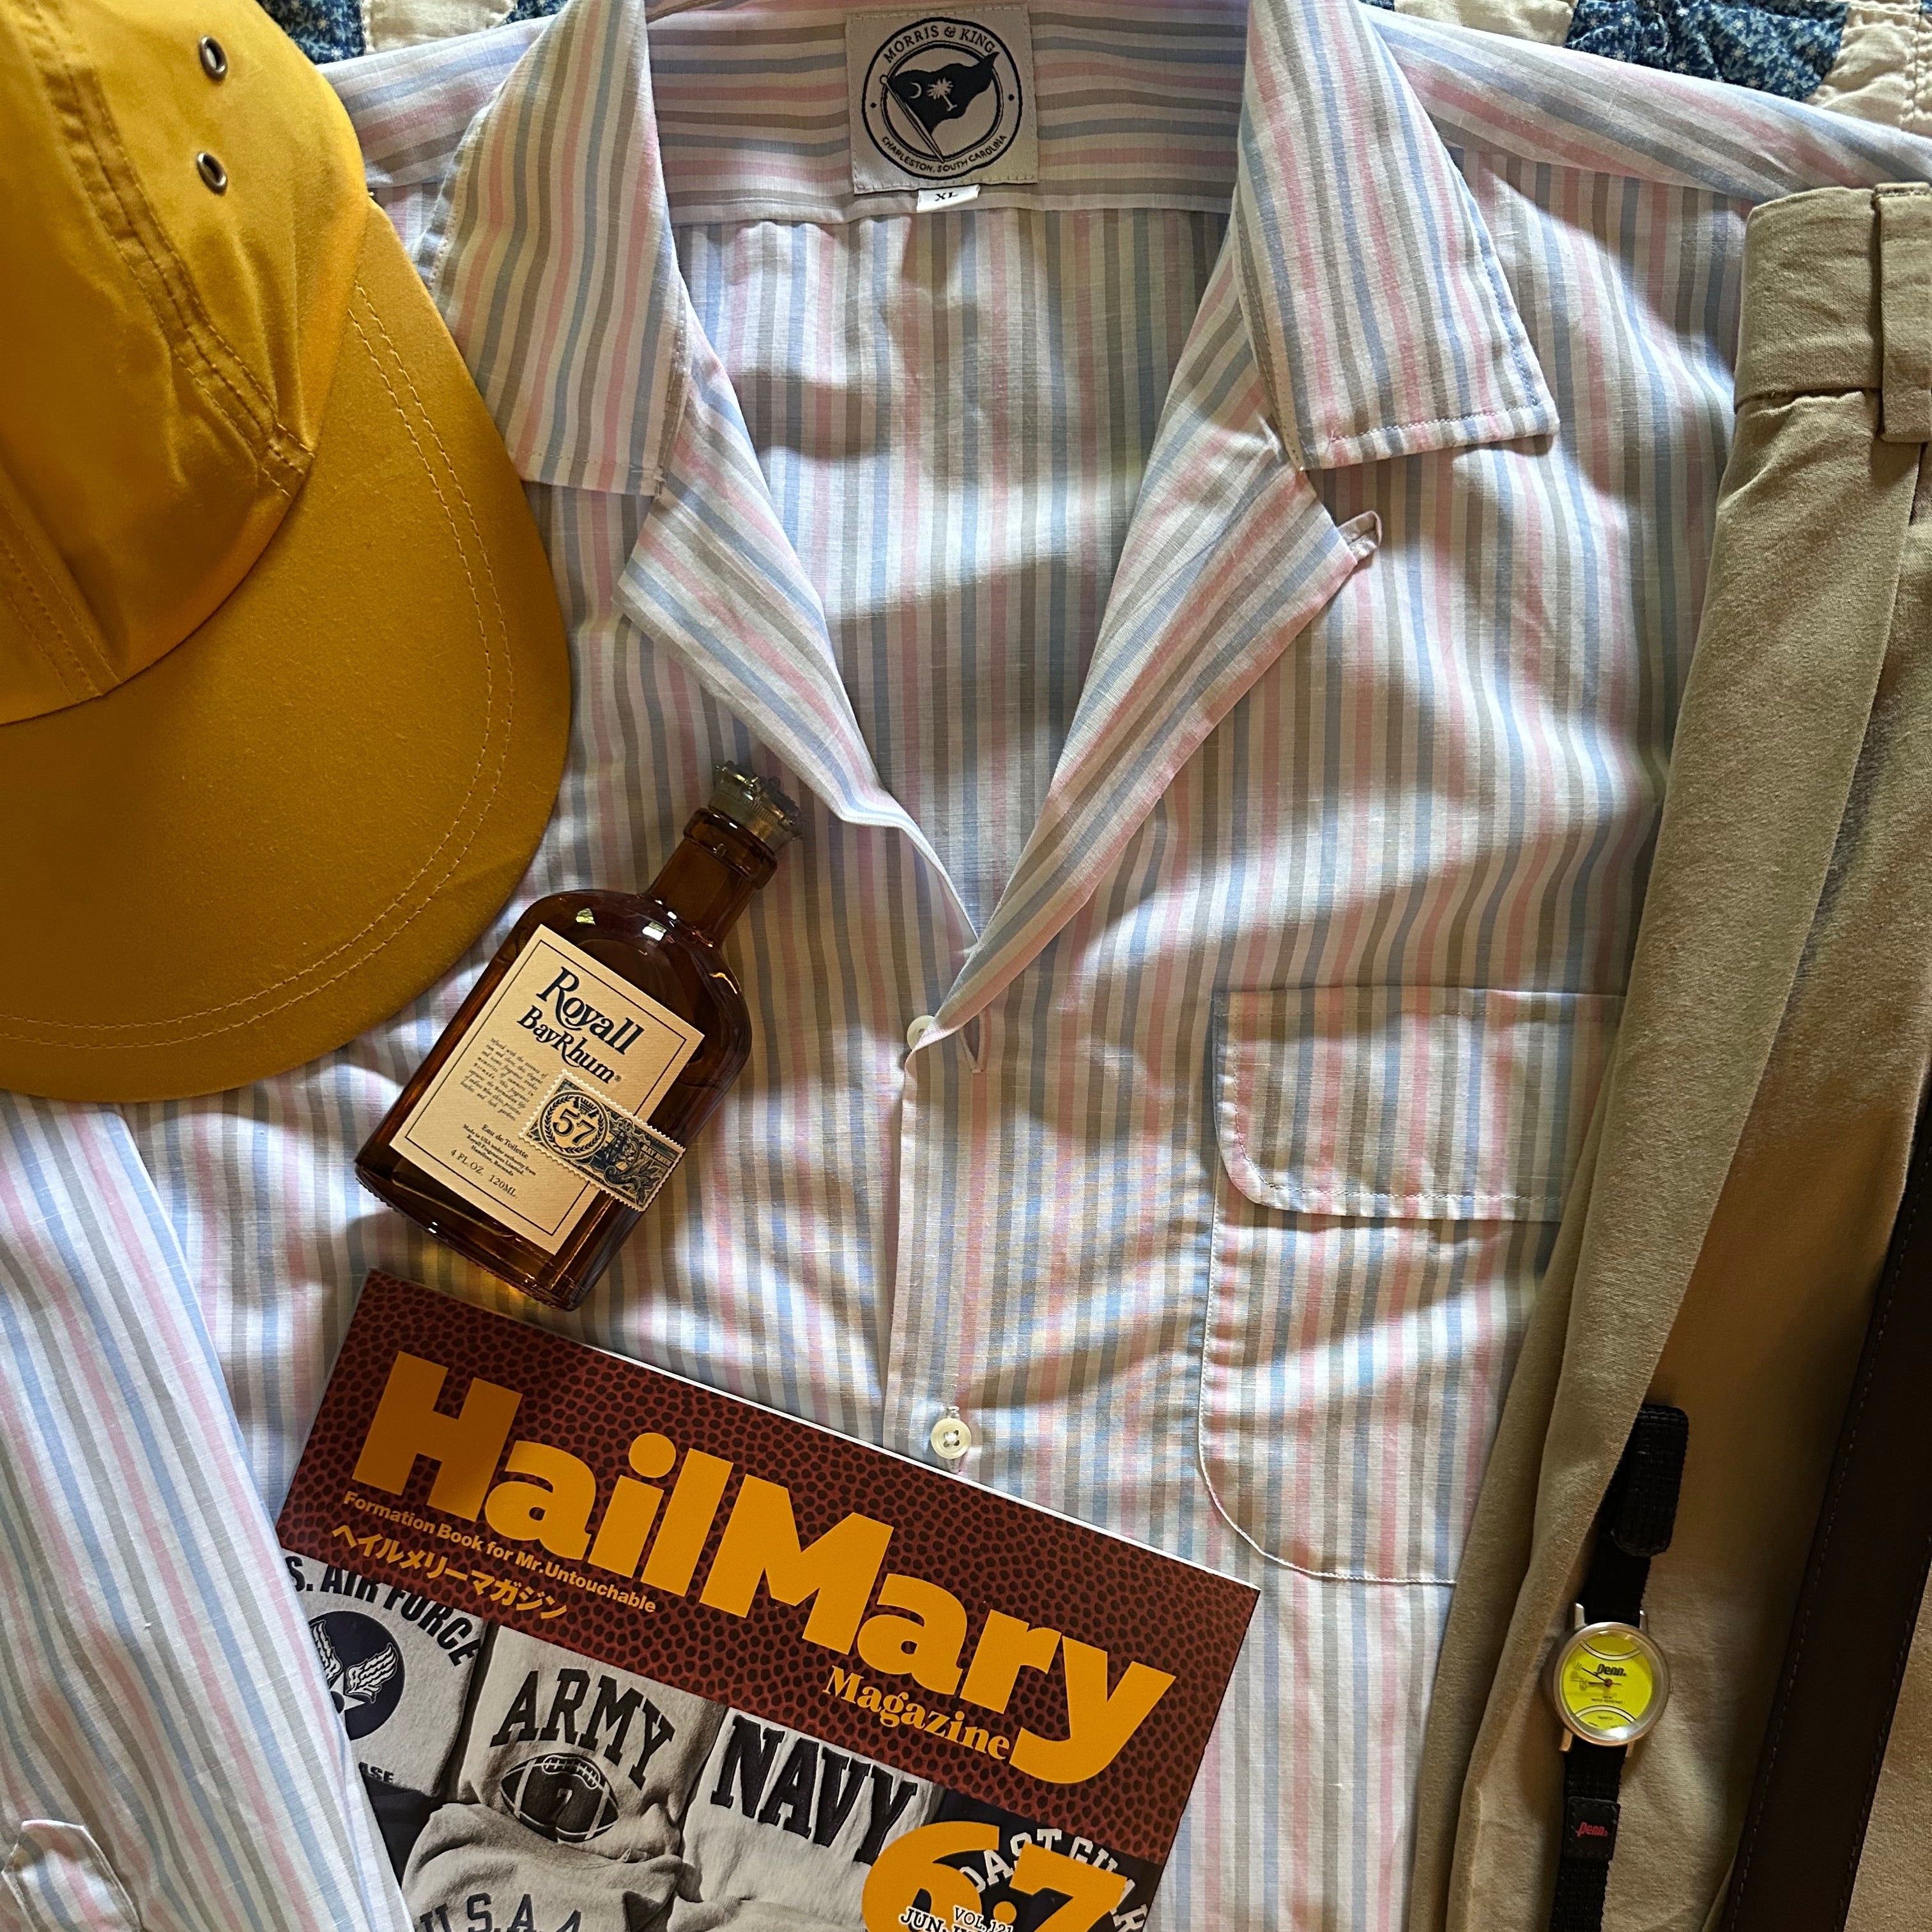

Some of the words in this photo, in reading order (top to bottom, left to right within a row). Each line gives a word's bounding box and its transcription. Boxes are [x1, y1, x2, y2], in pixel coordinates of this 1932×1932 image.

[884, 26, 939, 63] MORRIS
[944, 27, 956, 38] &
[960, 28, 995, 53] KING
[882, 137, 935, 173] CHARLESTON,
[937, 160, 968, 172] SOUTH
[969, 134, 1007, 162] CAROLINA
[935, 191, 959, 201] XL
[535, 966, 645, 1055] Royall
[480, 1136, 491, 1146] USA
[482, 1124, 495, 1137] Eau
[504, 1138, 529, 1159] Toilette
[552, 1109, 598, 1146] 57
[344, 1491, 435, 1534] Formation
[437, 1522, 483, 1551] Book
[486, 1540, 514, 1561] for
[332, 1524, 567, 1619] ヘイルメリーマガジン
[320, 1565, 381, 1603] AIR
[383, 1588, 481, 1667] FORCE
[490, 1667, 676, 1789] ARMY
[824, 1665, 1011, 1761] Magazine
[710, 1714, 918, 1864] NAVY
[954, 1907, 985, 1931] VOL.
